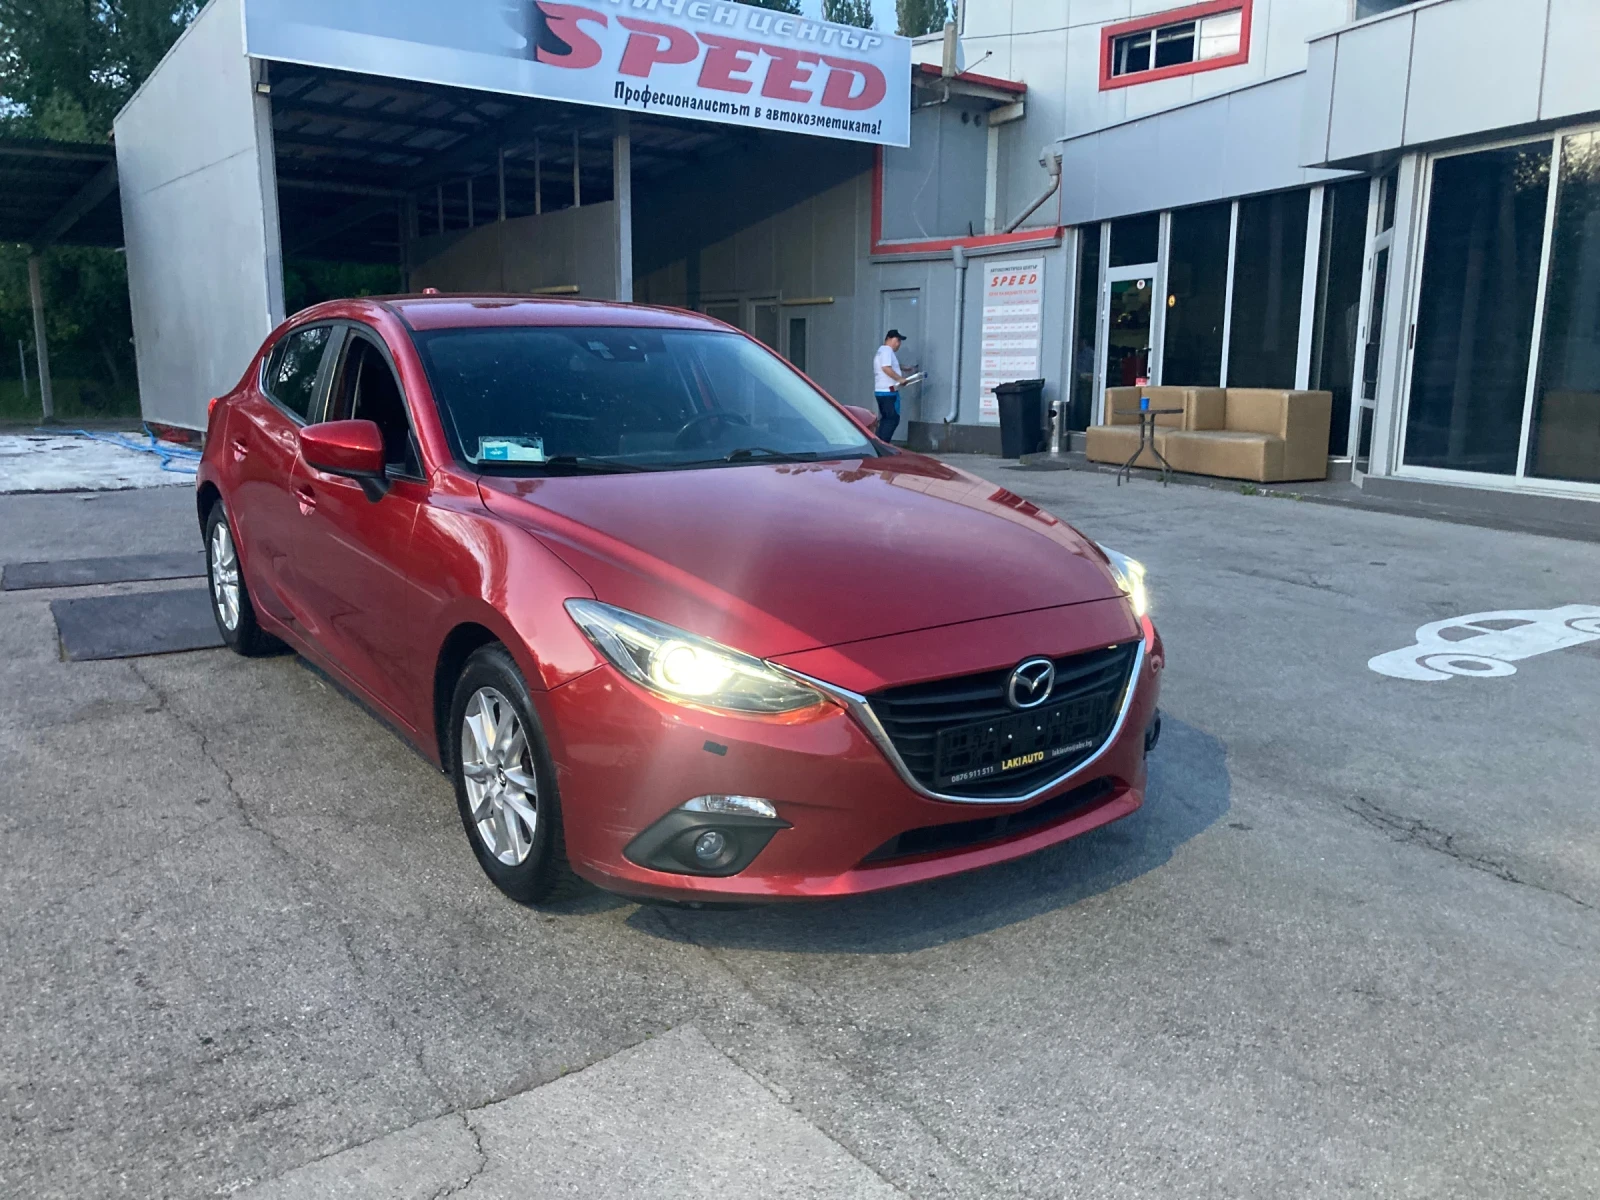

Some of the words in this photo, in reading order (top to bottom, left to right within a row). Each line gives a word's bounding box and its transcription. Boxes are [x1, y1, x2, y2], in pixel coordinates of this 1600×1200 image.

[748, 11, 882, 51] ЦЕНТЪР
[535, 1, 887, 111] SPEED
[614, 80, 750, 117] Професионалистът
[754, 106, 761, 118] в
[765, 108, 882, 135] автокозметиката!
[991, 273, 1037, 287] SPEED
